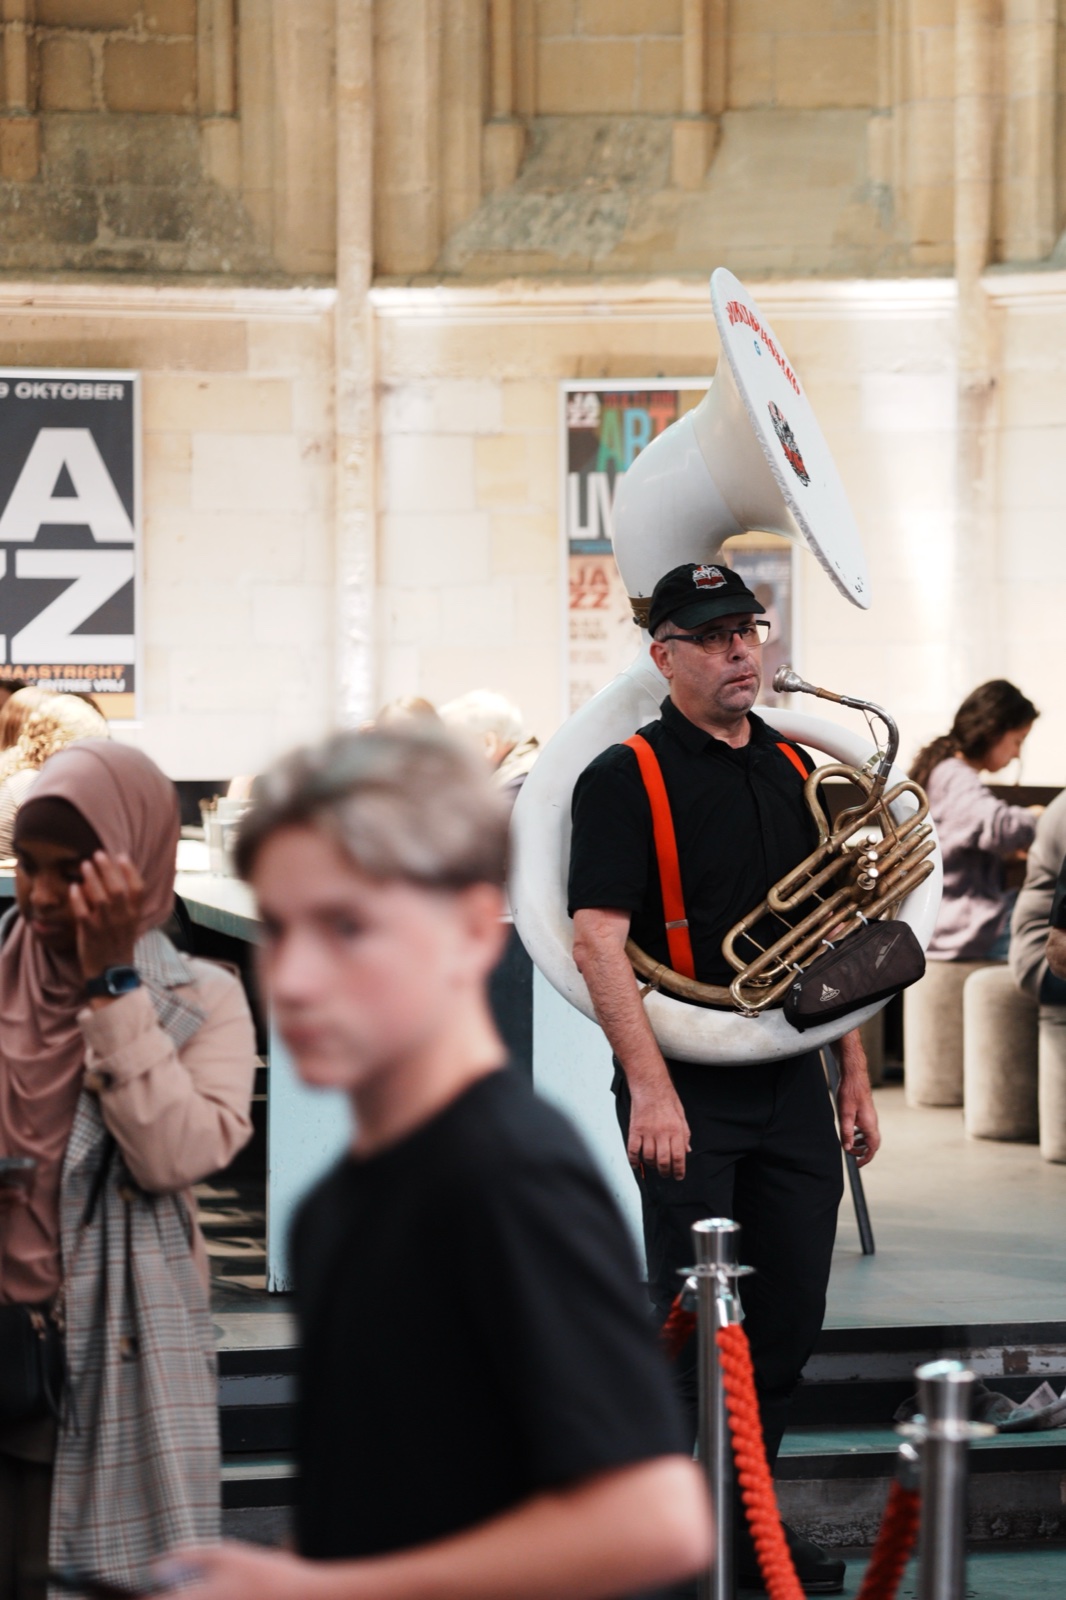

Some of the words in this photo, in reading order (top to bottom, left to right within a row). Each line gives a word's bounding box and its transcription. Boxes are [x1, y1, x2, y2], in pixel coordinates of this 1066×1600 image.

[14, 382, 125, 400] OKTOBER
[597, 407, 676, 472] ART
[0, 549, 135, 665] Z
